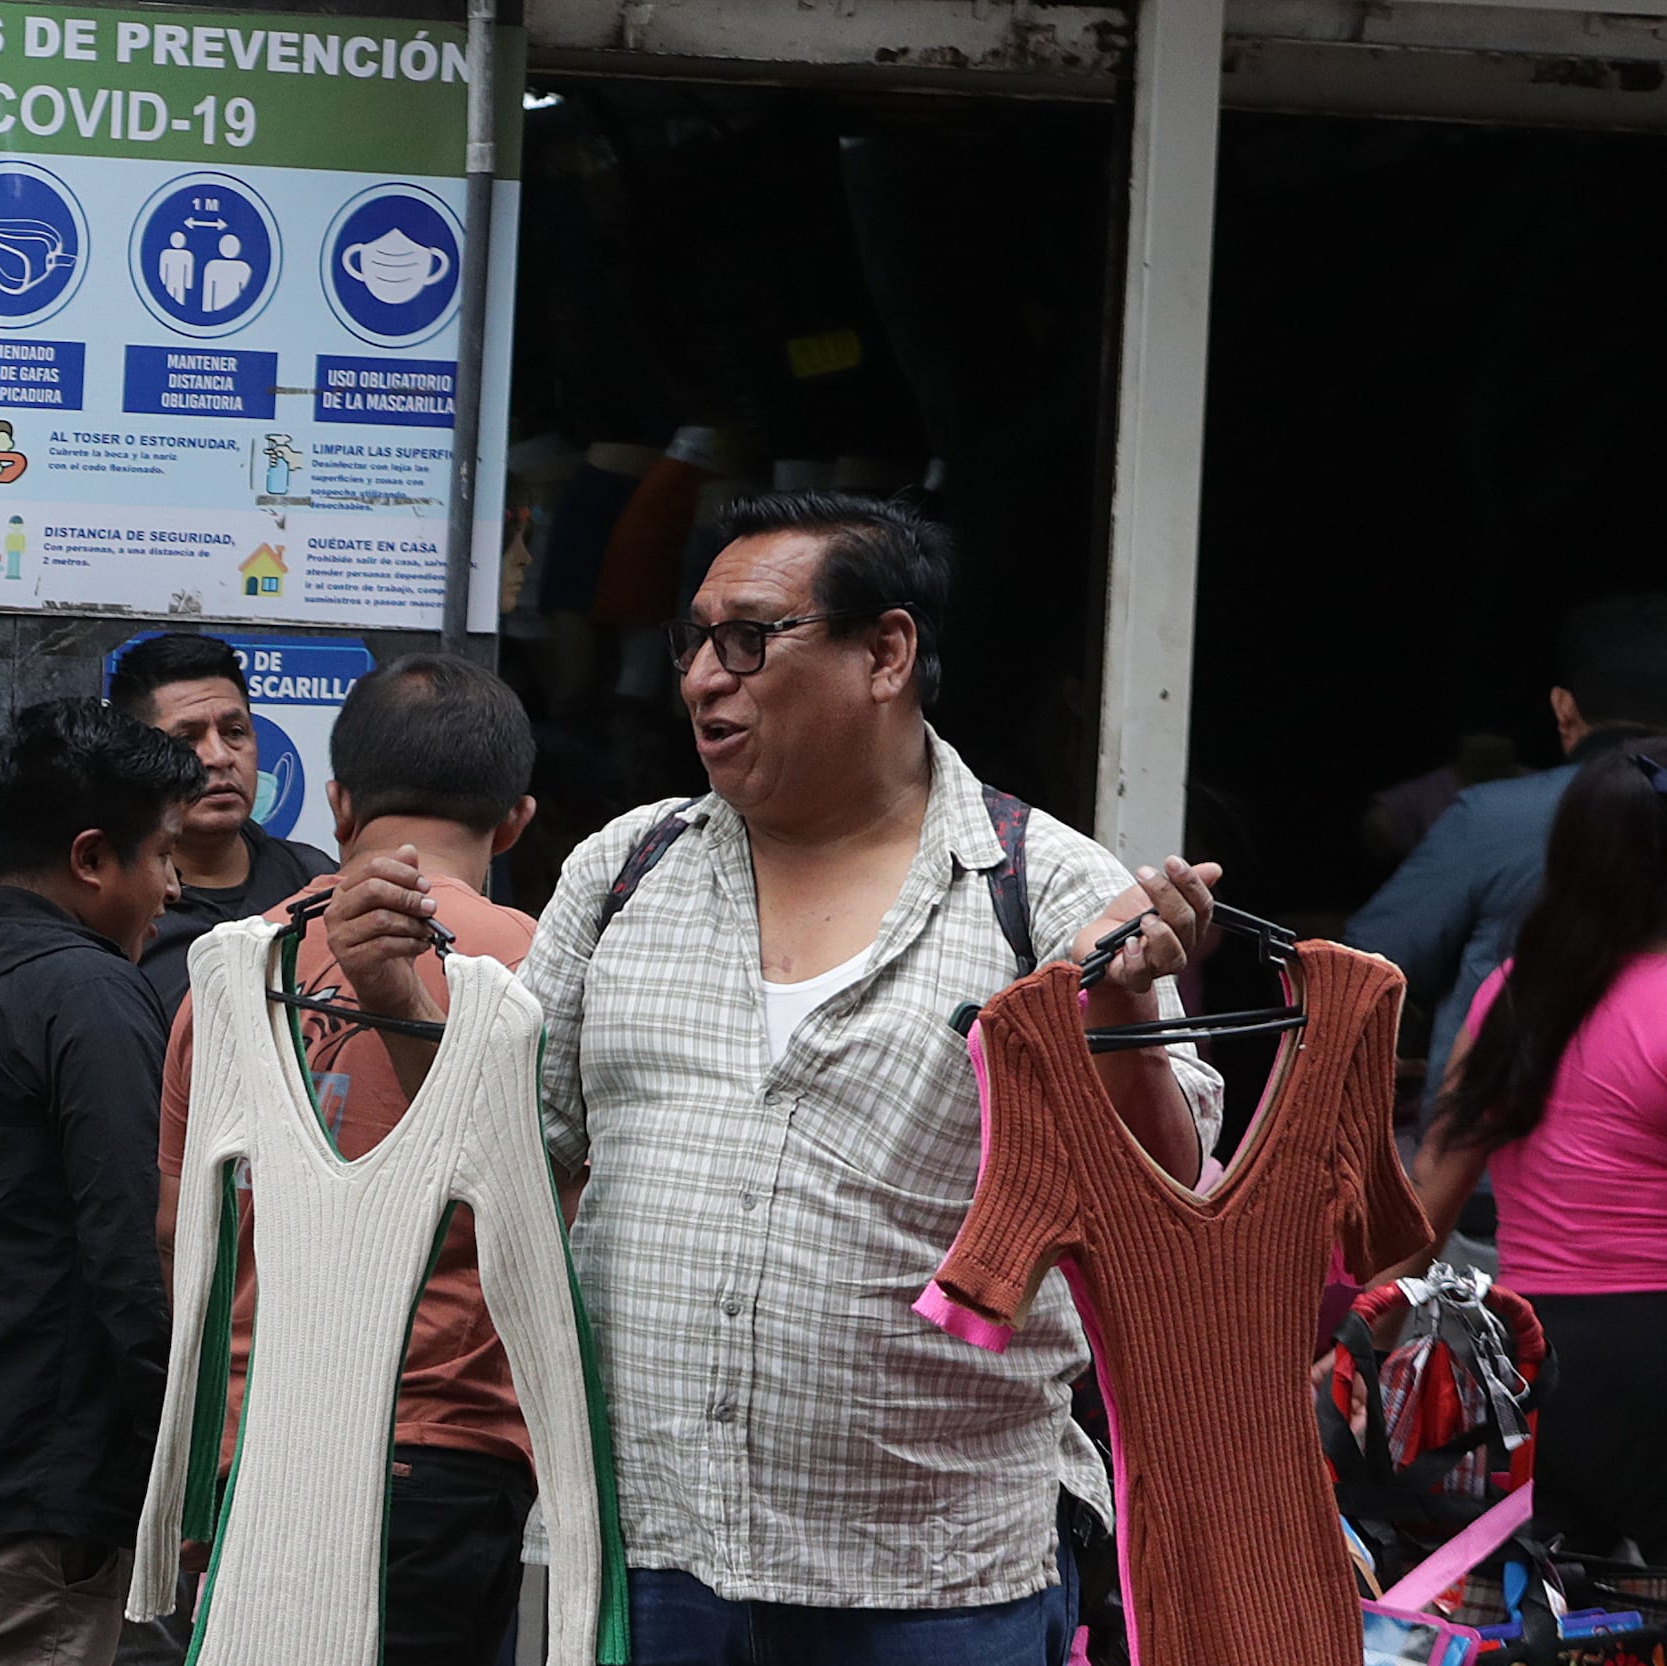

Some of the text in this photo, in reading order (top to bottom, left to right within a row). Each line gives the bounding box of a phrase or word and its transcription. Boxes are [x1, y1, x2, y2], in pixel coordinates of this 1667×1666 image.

[23, 17, 98, 61] DE
[116, 22, 469, 83] PREVENCIÓN
[192, 198, 219, 211] 1 M
[167, 354, 237, 372] MANTENER
[0, 366, 17, 382] DE
[20, 367, 59, 383] GAFAS
[168, 373, 234, 391] DISTANCIA
[327, 370, 452, 392] USO OBLIGATORIO
[161, 392, 243, 411] OBLIGATORIA
[322, 391, 456, 414] DE LA MASCARILLA
[49, 431, 241, 451] AL TOSER O ESTORNUDAR,
[92, 449, 102, 457] la
[104, 449, 129, 459] boca
[131, 452, 137, 460] y
[140, 451, 150, 459] la
[153, 452, 178, 461] nariz
[312, 443, 364, 456] LIMPIAR
[368, 446, 392, 458] LAS
[82, 463, 107, 472] codo
[414, 464, 429, 472] las
[366, 477, 372, 485] y
[43, 527, 236, 547] DISTANCIA DE SEGURIDAD,
[43, 543, 64, 551] Con
[127, 547, 146, 556] una
[149, 547, 195, 558] distancia
[198, 548, 210, 558] de
[308, 537, 438, 554] QUÉDATE EN CASA
[42, 557, 49, 565] 2
[306, 554, 353, 564] Prohibido
[356, 556, 376, 564] salir
[379, 557, 392, 565] de
[305, 568, 343, 577] atender
[346, 570, 391, 579] personas
[327, 583, 359, 591] centro
[362, 583, 373, 592] de
[254, 650, 282, 672] DE
